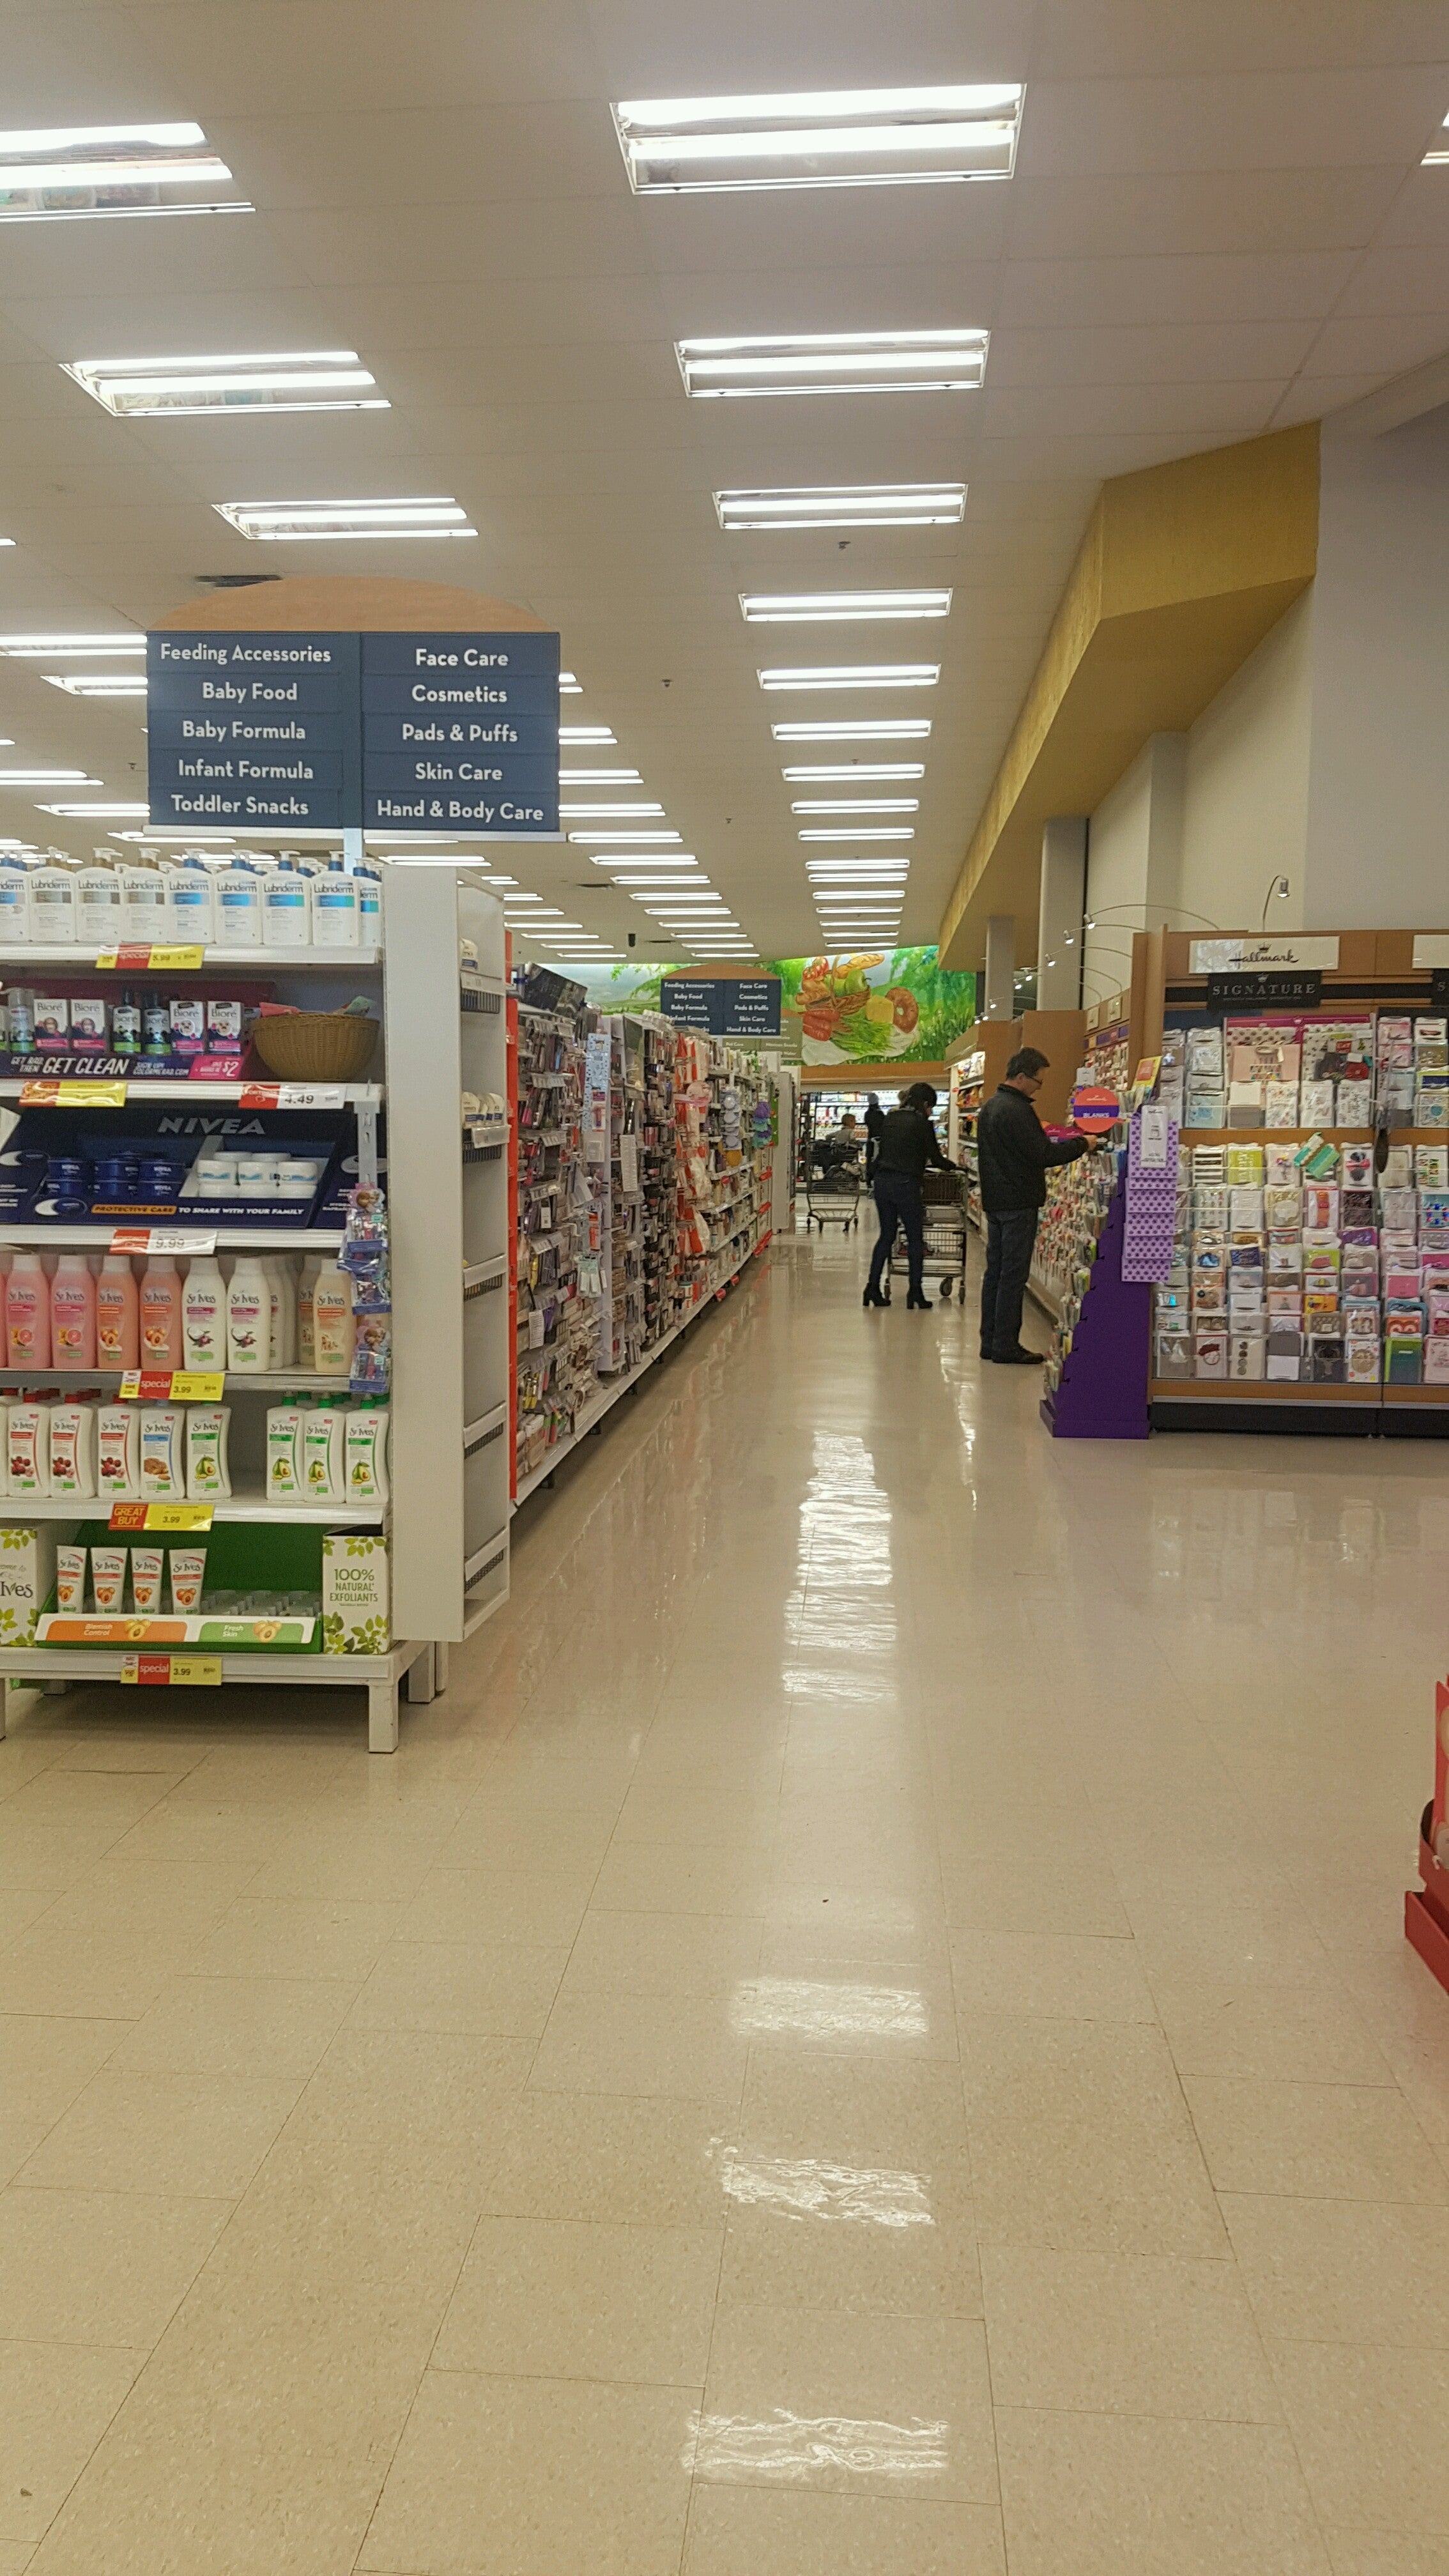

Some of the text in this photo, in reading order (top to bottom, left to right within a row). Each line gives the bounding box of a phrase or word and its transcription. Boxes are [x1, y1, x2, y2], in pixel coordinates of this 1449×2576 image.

[160, 643, 331, 664] Feeding Accessories
[415, 648, 509, 667] Face Care
[203, 682, 298, 703] Baby Food
[411, 684, 507, 703] Cosmetics
[183, 721, 306, 741] Baby Formula
[402, 724, 518, 742] Pads & Puffs
[178, 759, 313, 779] Infant Formula
[415, 763, 503, 781] Skin Care
[171, 793, 309, 815] Toddler Snacks
[378, 799, 544, 822] Hand & Body Care
[31, 879, 70, 889] Lubriderm
[78, 880, 119, 891] Lubriderm
[123, 880, 164, 891] Lubriderm
[169, 880, 210, 892] Lubriderm
[217, 882, 257, 893] Lubriderm
[264, 883, 303, 893] Lubriderm
[314, 884, 354, 894] Lubriderm
[1229, 949, 1301, 969] Hallmark
[1212, 983, 1316, 995] SIGNATURE
[42, 1056, 129, 1075] GET CLEAN
[223, 1061, 240, 1077] $2
[284, 1094, 314, 1104] 4.49
[157, 1117, 266, 1135] NIVEA
[155, 1238, 185, 1248] 9.99
[141, 1379, 171, 1390] special
[114, 1507, 146, 1516] GREAT
[117, 1516, 139, 1525] BUY
[334, 1568, 375, 1581] 100%
[0, 1581, 33, 1598] Ives
[329, 1592, 378, 1602] EXFOLIANTS
[139, 1664, 191, 1676] special 3.99
